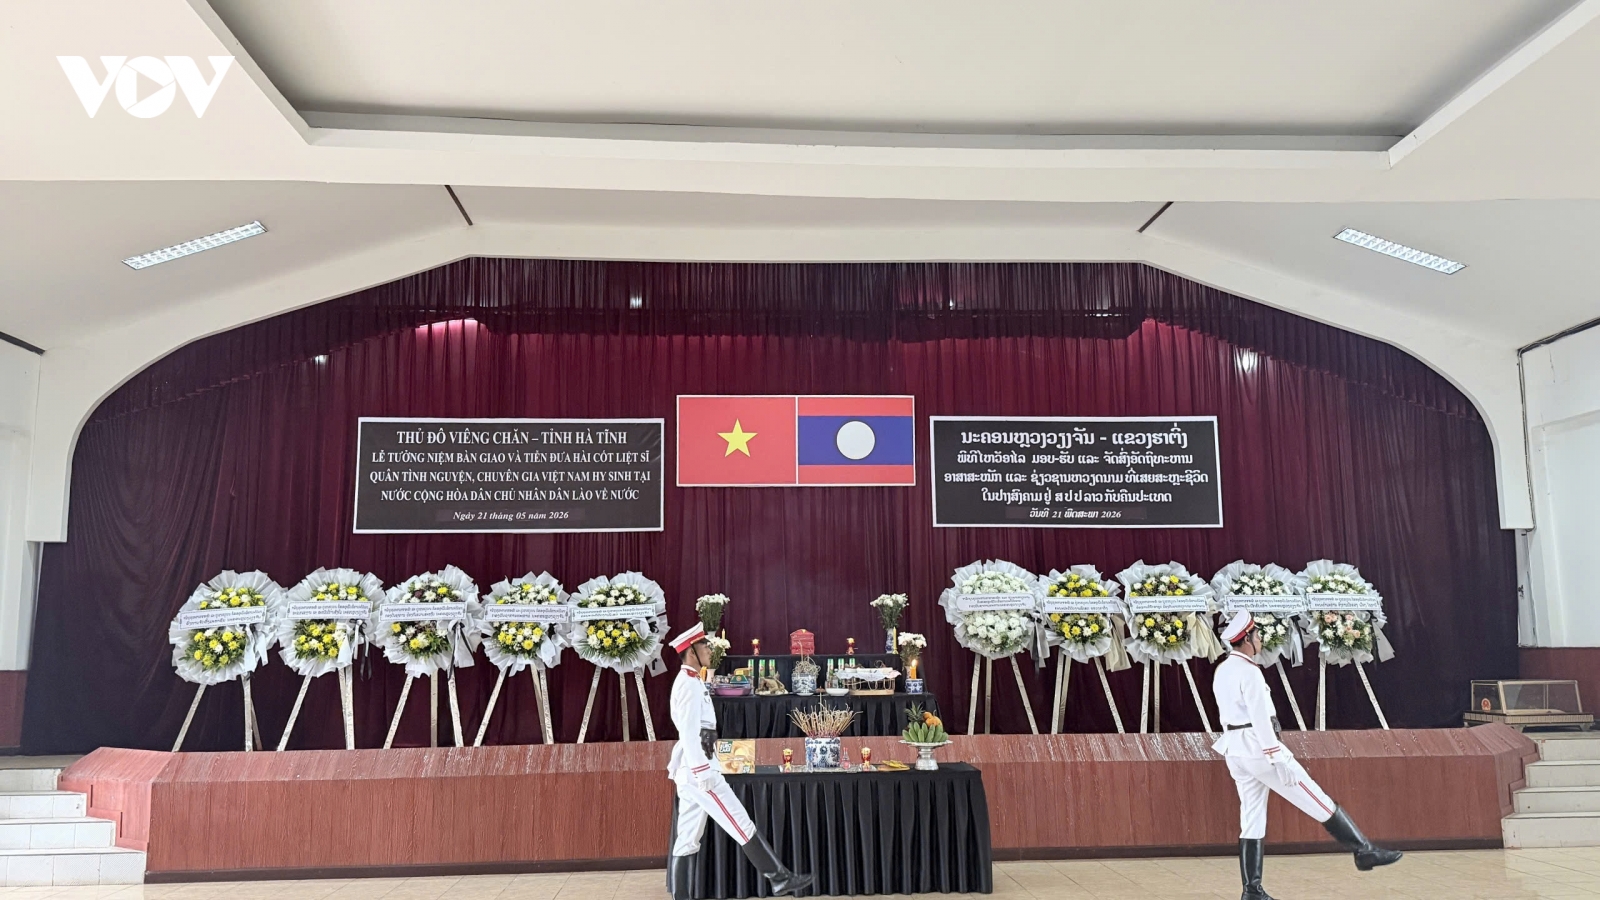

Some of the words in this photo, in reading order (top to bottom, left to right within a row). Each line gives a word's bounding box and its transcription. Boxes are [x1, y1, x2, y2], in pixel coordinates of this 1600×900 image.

[397, 428, 424, 444] THỦ
[427, 428, 446, 444] ĐÔ
[449, 428, 489, 444] VIÊNG
[493, 429, 529, 444] CHĂN
[541, 428, 572, 444] TỈNH
[576, 428, 593, 444] HÀ
[596, 429, 627, 444] TĨNH
[388, 450, 424, 462] TƯỞNG
[427, 451, 454, 465] NIỆM
[457, 450, 477, 462] BÀN
[480, 453, 505, 463] GIAO
[508, 450, 521, 462] VÀ
[550, 452, 571, 462] ĐƯA
[573, 450, 590, 462] HÀI
[616, 451, 638, 465] LIỆT
[1078, 455, 1099, 464] ແລະ
[370, 468, 399, 483] QUÂN
[402, 469, 427, 481] TÌNH
[430, 470, 474, 484] NGUYỆN,
[477, 469, 519, 482] CHUYÊN
[522, 472, 540, 482] GIA
[542, 470, 565, 484] VIỆT
[567, 472, 590, 481] NAM
[593, 472, 606, 481] HY
[609, 471, 631, 481] SINH
[634, 471, 650, 483] TẠI
[1006, 473, 1027, 482] ແລະ
[381, 488, 411, 500] NƯỚC
[414, 489, 443, 503] CỘNG
[446, 488, 468, 500] HÒA
[470, 488, 491, 500] DÂN
[494, 488, 515, 500] CHỦ
[518, 488, 546, 500] NHÂN
[549, 487, 569, 500] DÂN
[572, 487, 593, 500] LÀO
[611, 487, 639, 500] NƯỚC
[453, 512, 475, 521] Ngày
[489, 512, 513, 521] tháng
